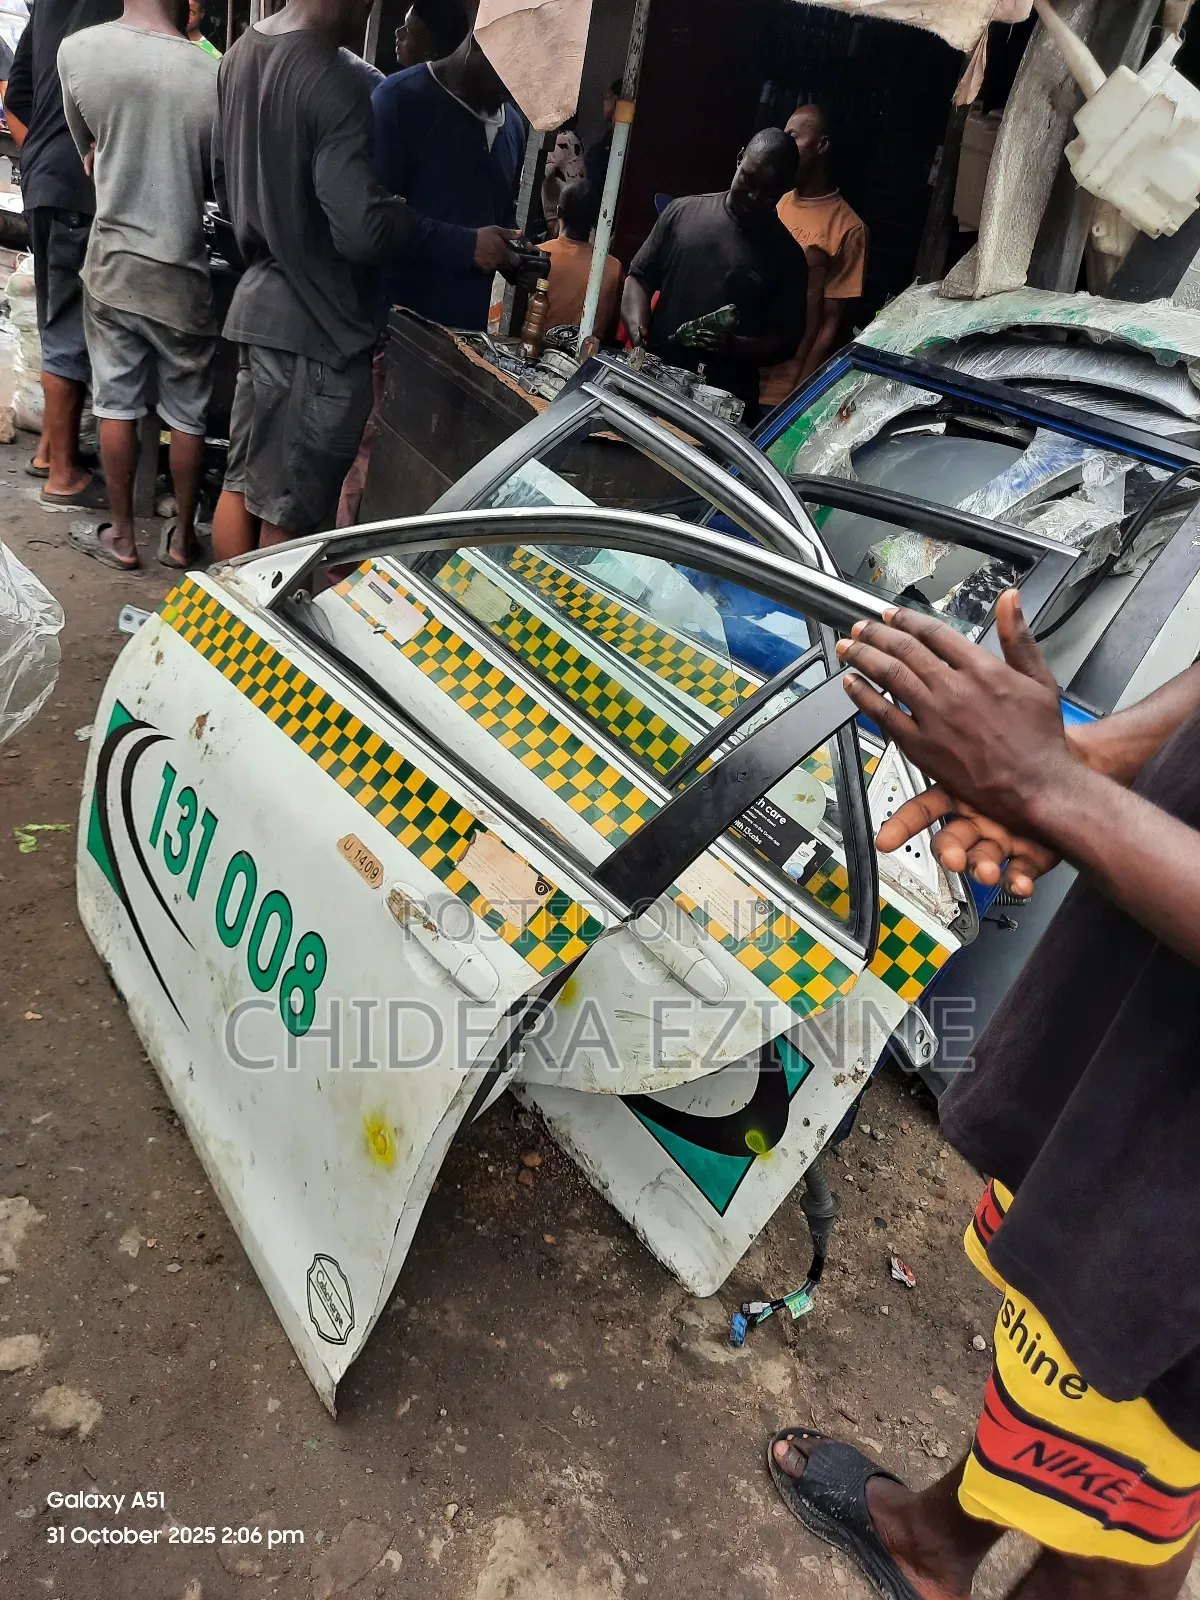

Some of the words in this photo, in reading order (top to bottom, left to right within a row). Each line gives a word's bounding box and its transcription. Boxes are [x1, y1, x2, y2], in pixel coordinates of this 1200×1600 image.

[743, 826, 763, 845] 13cabs
[765, 805, 787, 825] care
[149, 760, 219, 901] 131
[215, 849, 328, 1038] 008
[316, 1270, 345, 1329] Cabcharge
[1013, 1440, 1133, 1504] NIKE
